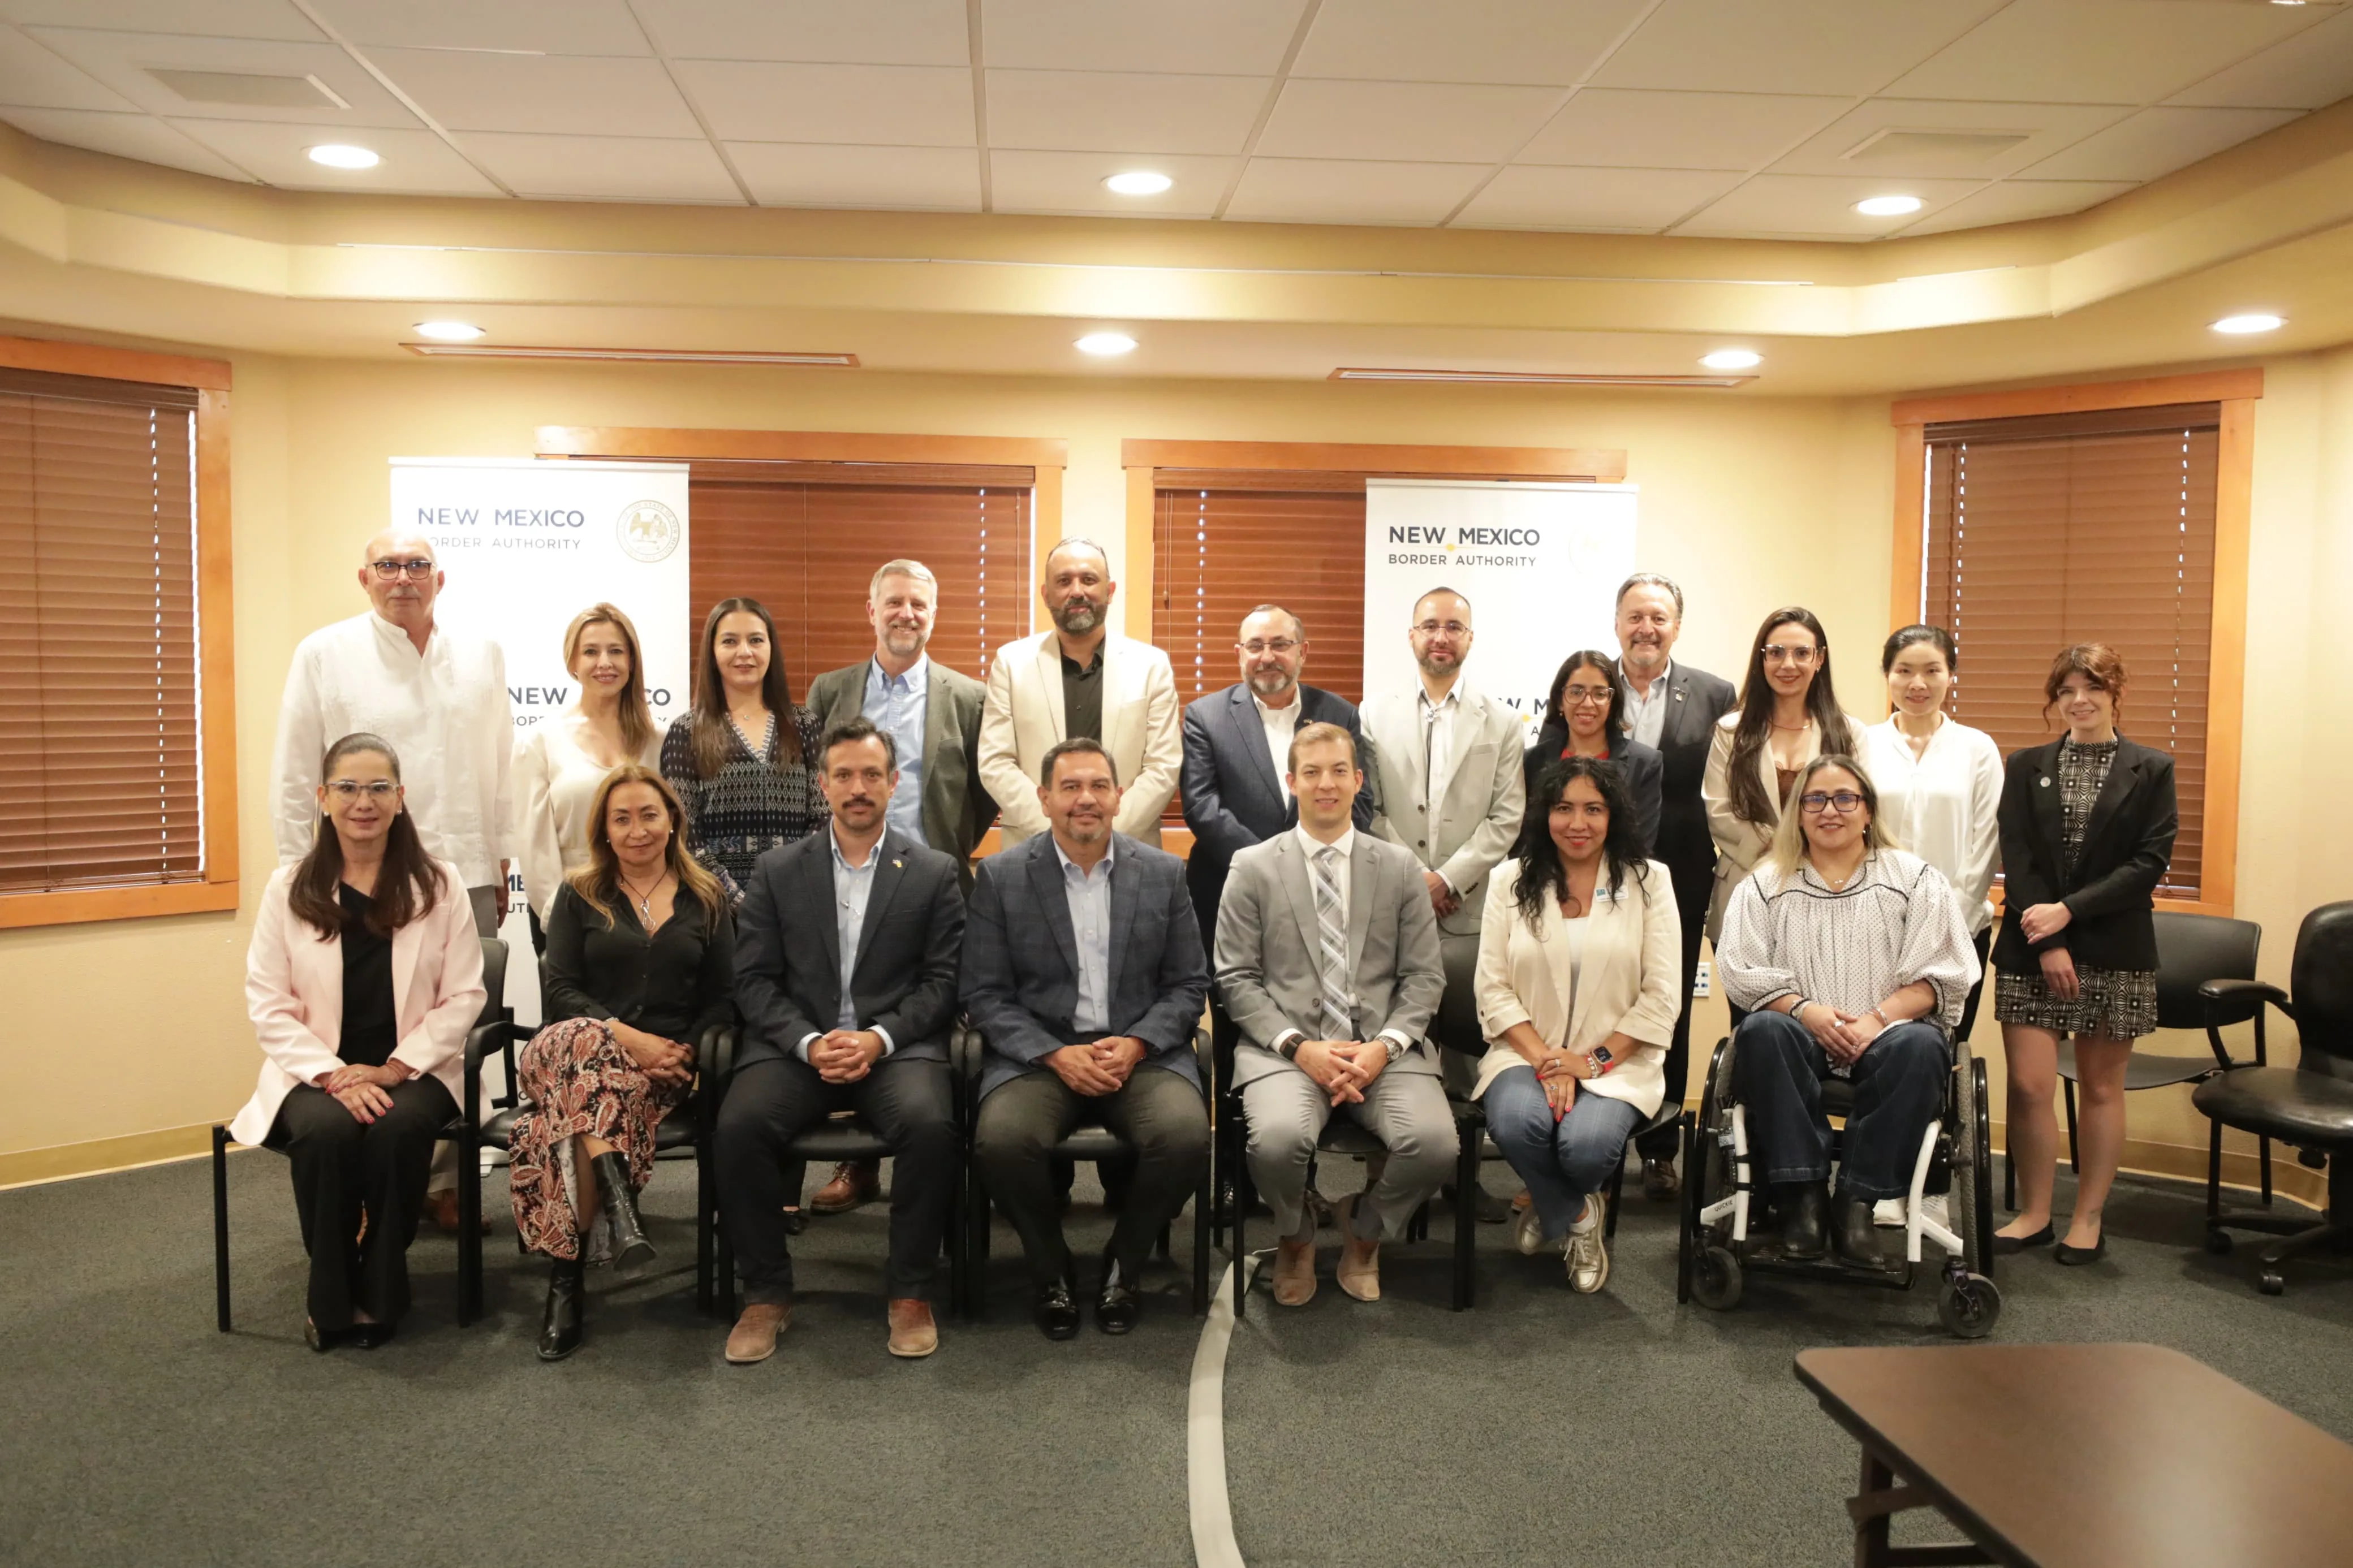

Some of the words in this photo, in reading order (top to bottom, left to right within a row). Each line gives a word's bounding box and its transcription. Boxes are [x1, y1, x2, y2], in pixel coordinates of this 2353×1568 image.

[418, 508, 479, 525] NEW
[495, 509, 585, 528] MEXICO
[429, 537, 481, 548] ORDER
[492, 538, 581, 549] AUTHORITY
[1389, 526, 1446, 543] NEW
[1459, 528, 1540, 546] MEXICO
[1389, 554, 1446, 565] BORDER
[1456, 555, 1536, 567] AUTHORITY
[507, 687, 567, 705] NEW
[1714, 1199, 1733, 1212] QUICKIE
